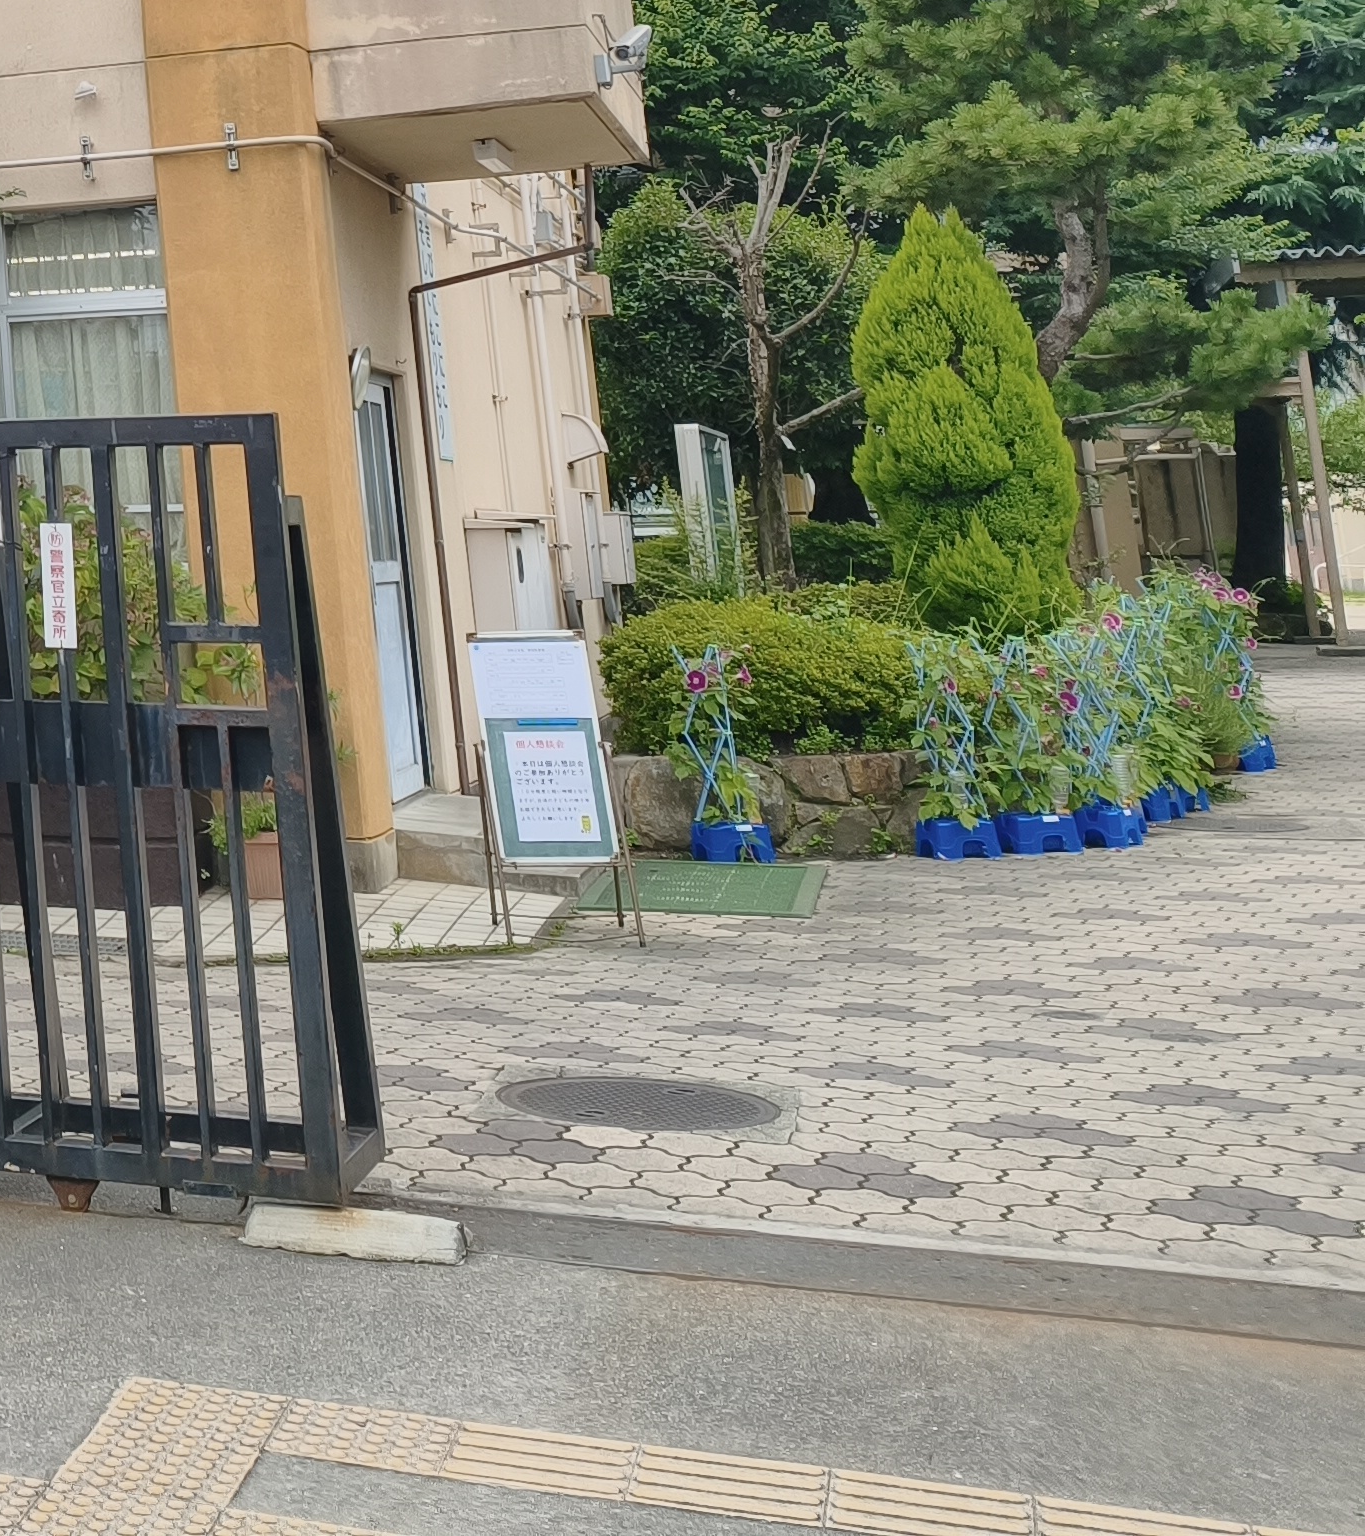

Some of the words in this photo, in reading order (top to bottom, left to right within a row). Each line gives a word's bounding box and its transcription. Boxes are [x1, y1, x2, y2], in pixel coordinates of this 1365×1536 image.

[50, 549, 67, 639] 警察官立寄所
[515, 740, 564, 749] 個人懇談会
